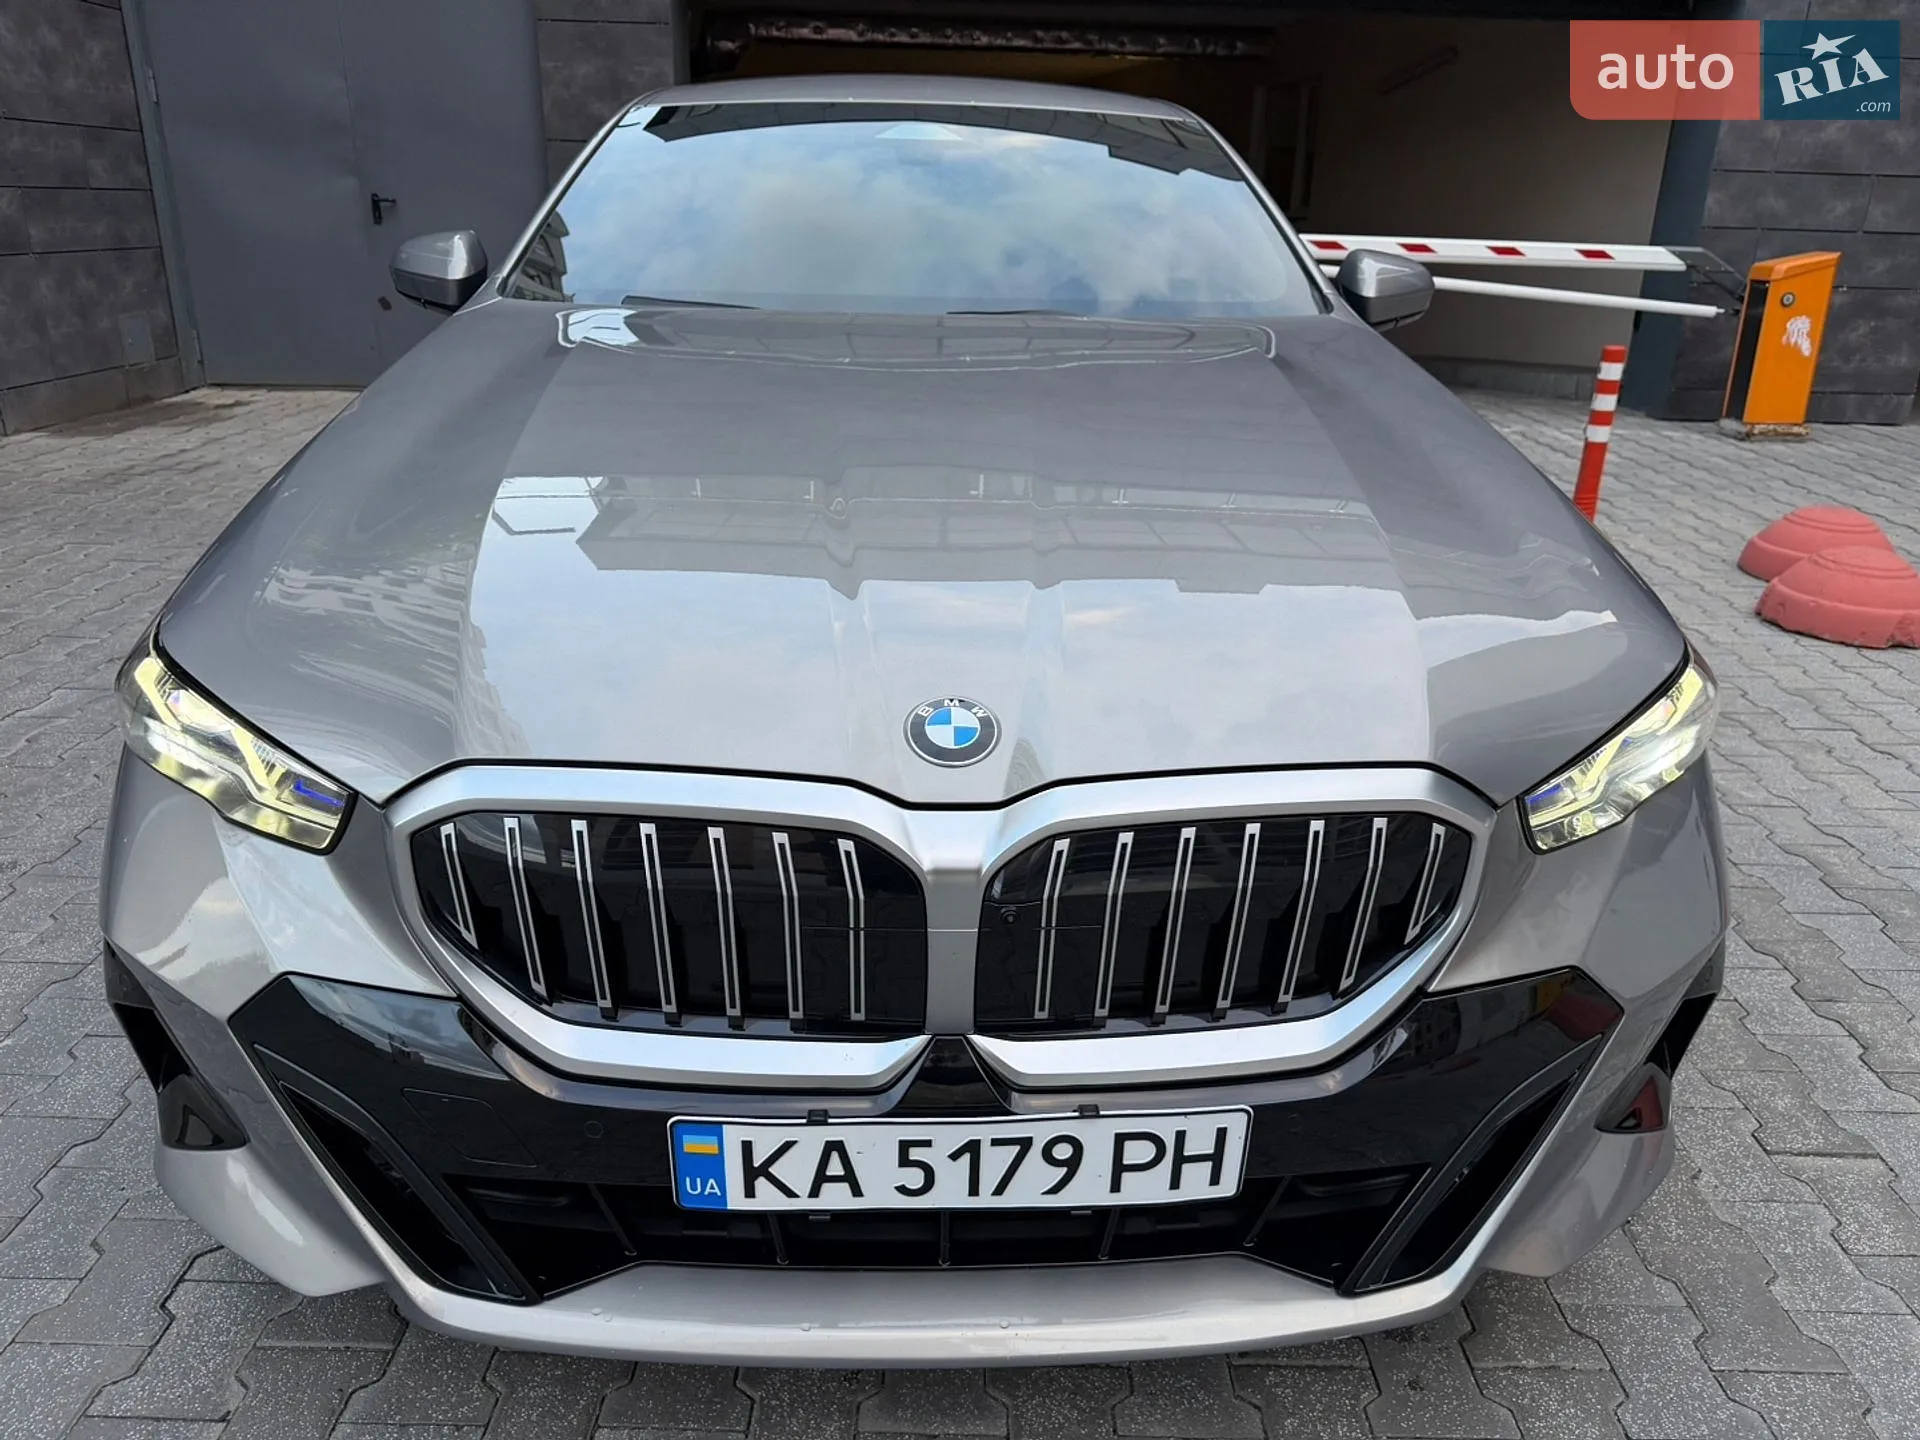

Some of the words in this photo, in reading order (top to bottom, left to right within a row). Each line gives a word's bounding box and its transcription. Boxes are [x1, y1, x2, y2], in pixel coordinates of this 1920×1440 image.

[918, 698, 988, 718] BMW
[740, 1139, 864, 1198] KA
[893, 1134, 1083, 1197] 5179
[1109, 1127, 1228, 1194] PH
[686, 1176, 722, 1197] UA
